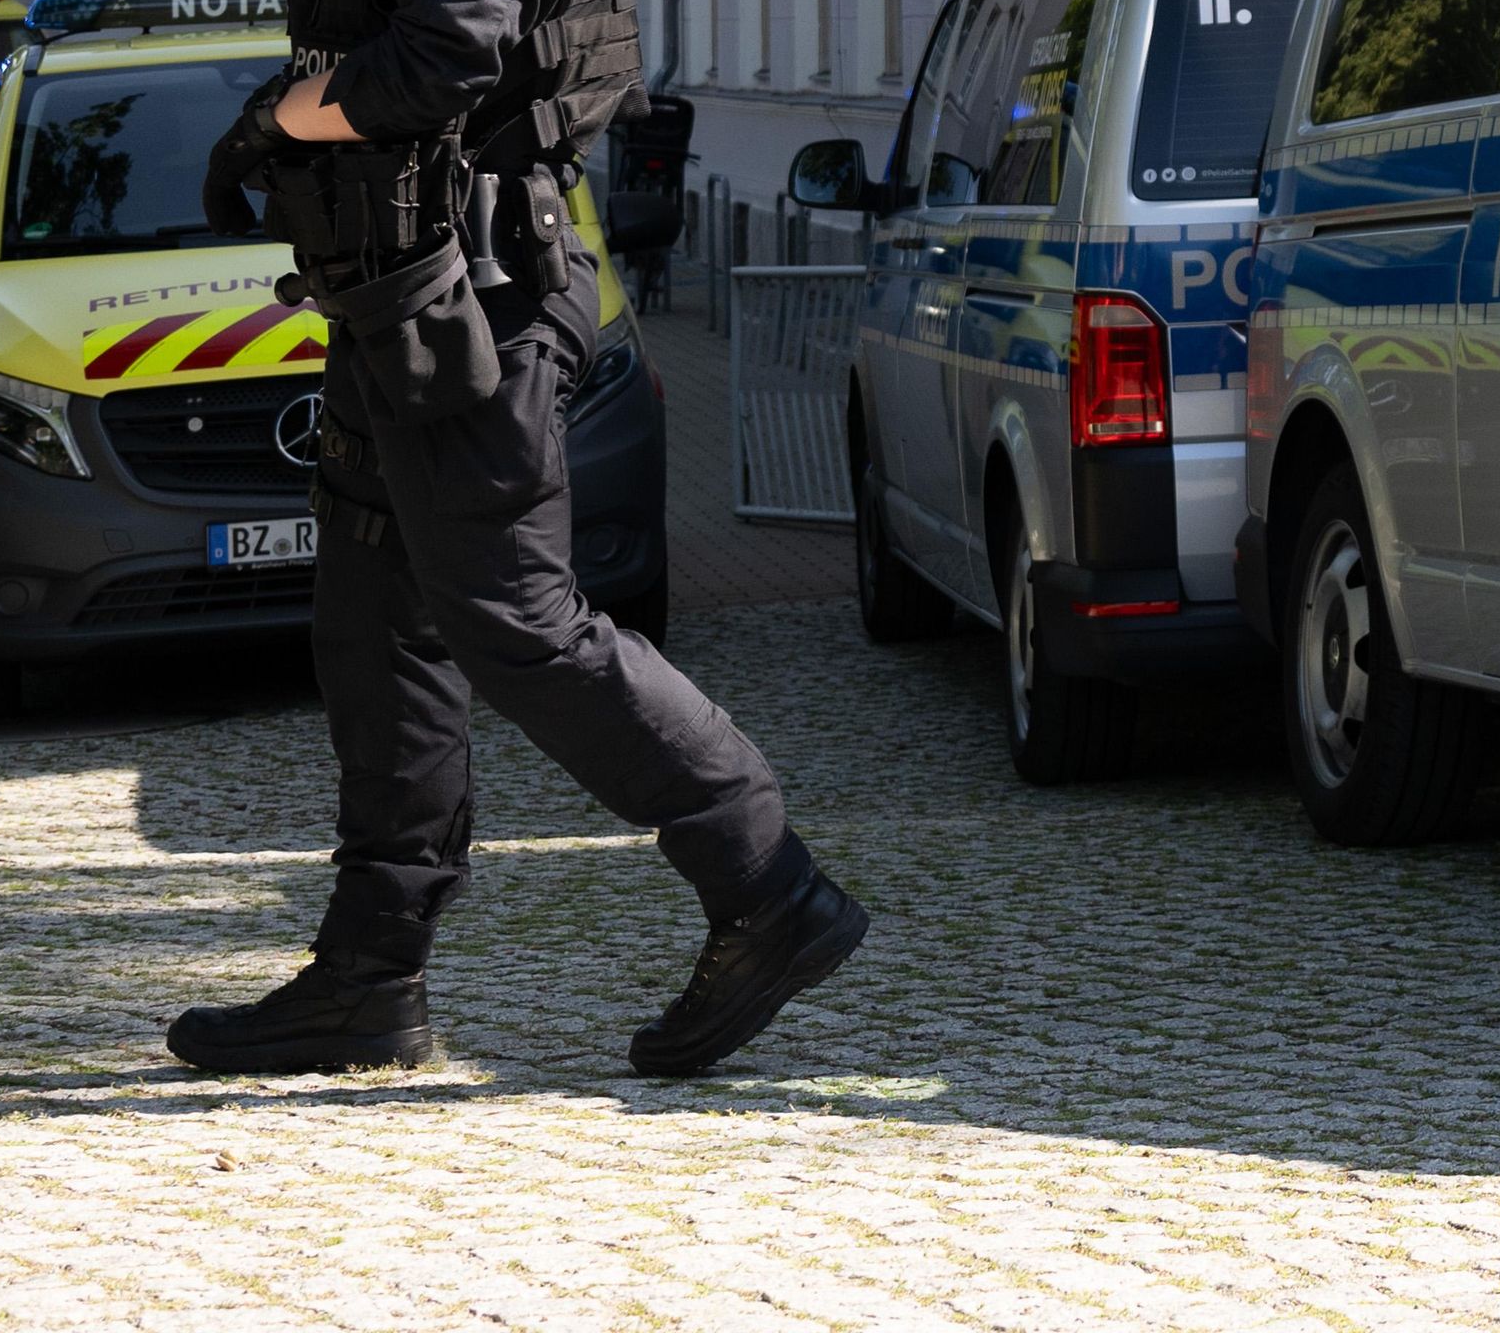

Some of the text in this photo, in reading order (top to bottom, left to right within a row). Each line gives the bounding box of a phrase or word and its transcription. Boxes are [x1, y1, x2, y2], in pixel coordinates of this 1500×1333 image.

[89, 275, 272, 313] RETTUN
[1171, 246, 1252, 310] PO
[232, 525, 270, 558] BZ
[296, 522, 313, 553] R
